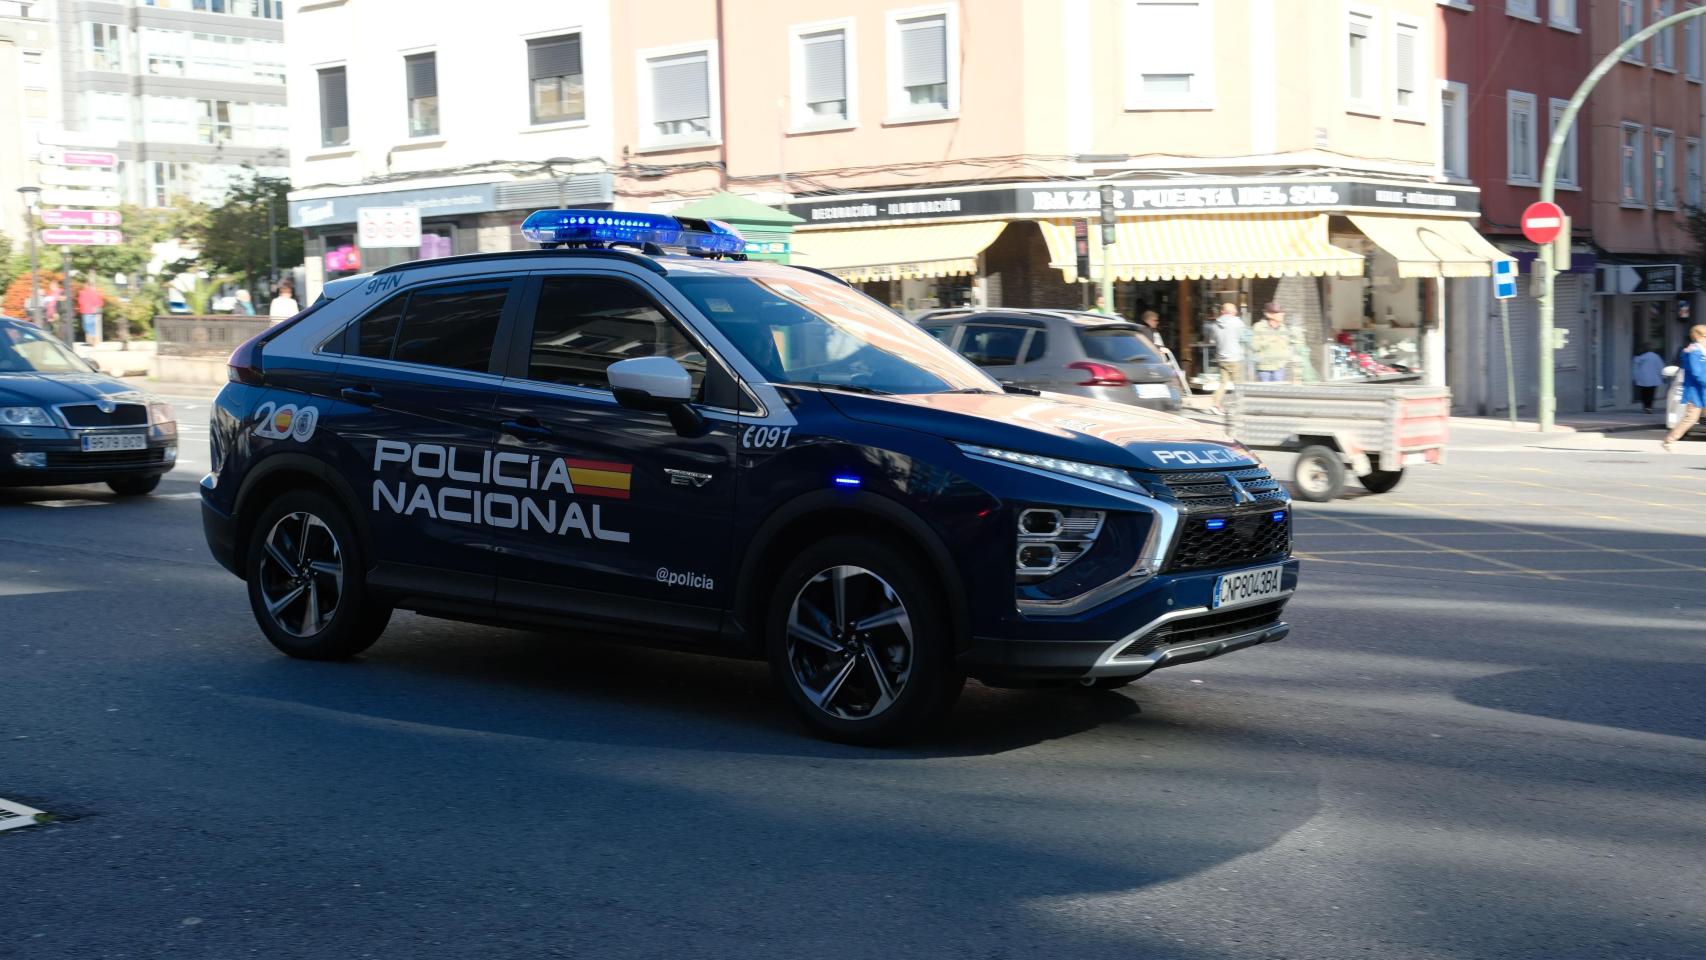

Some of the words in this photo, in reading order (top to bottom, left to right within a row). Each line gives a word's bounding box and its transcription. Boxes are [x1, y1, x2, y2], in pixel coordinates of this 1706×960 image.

[1032, 190, 1126, 210] BAZAR
[1132, 187, 1237, 208] PUERTA
[1238, 186, 1287, 205] DEL
[1289, 185, 1339, 204] SOL
[365, 272, 404, 295] 9HN
[373, 479, 630, 543] NACIONAL
[656, 567, 714, 590] @policia
[1221, 569, 1278, 602] CNP8043BA
